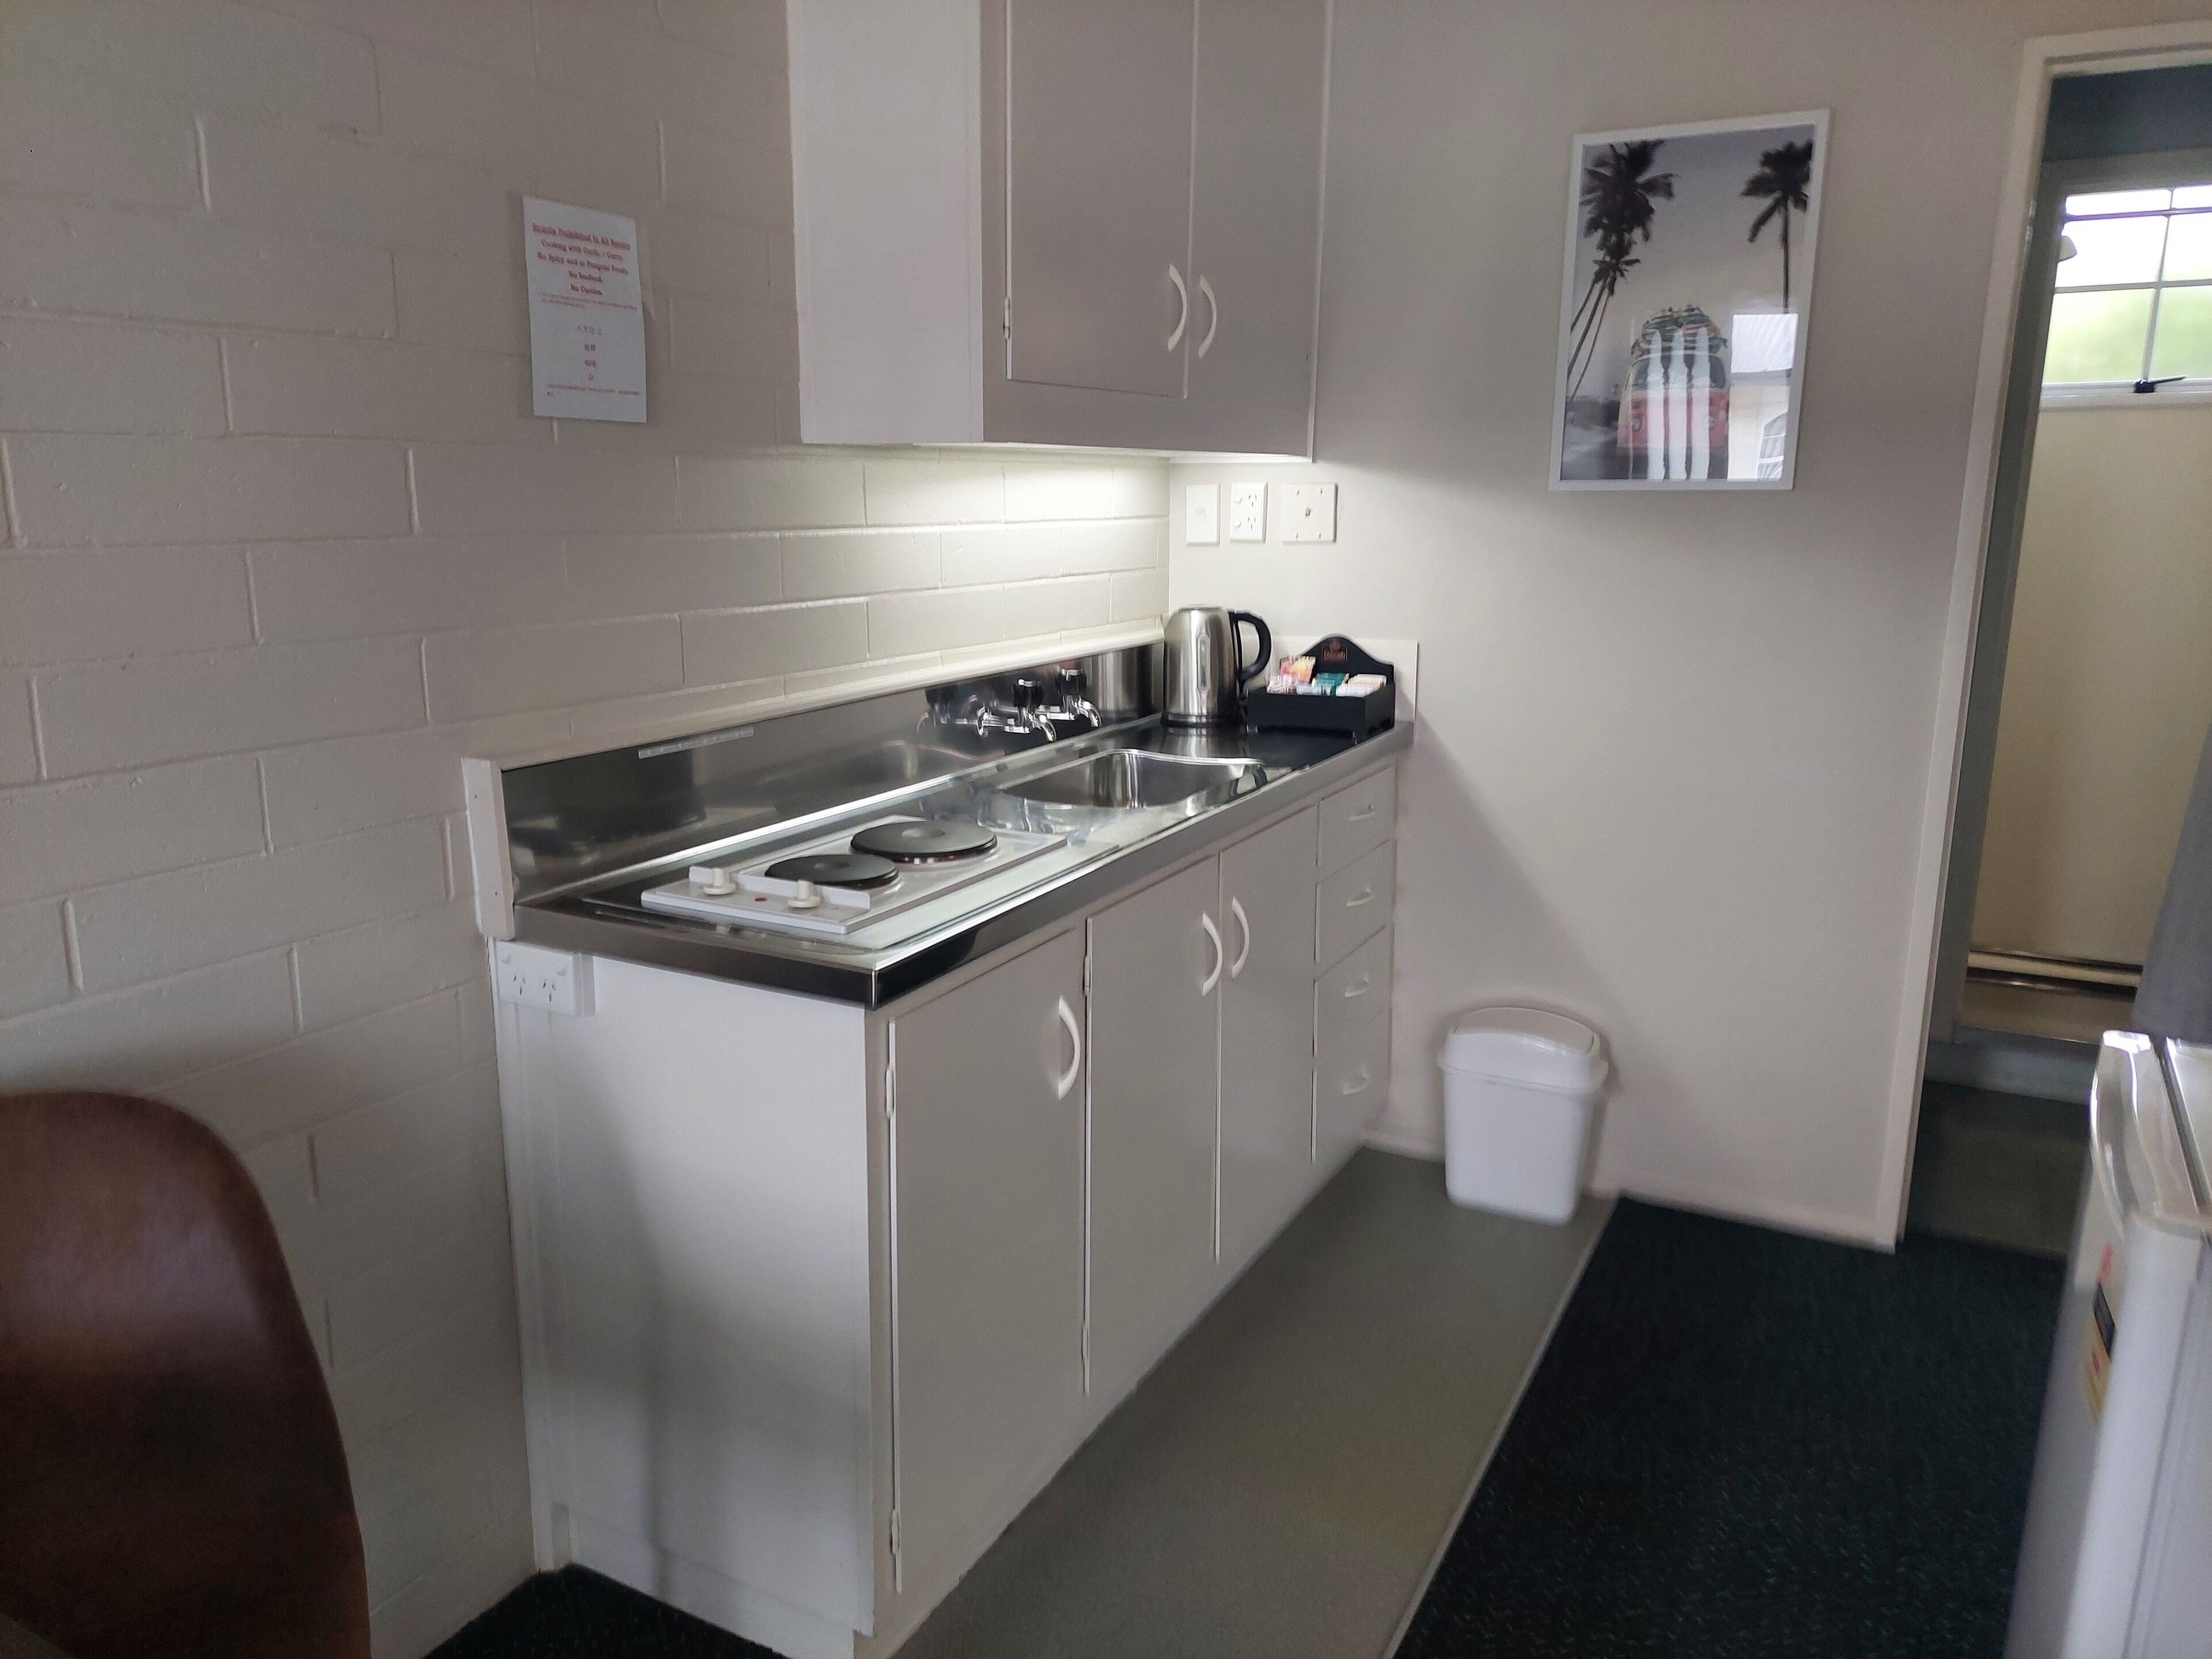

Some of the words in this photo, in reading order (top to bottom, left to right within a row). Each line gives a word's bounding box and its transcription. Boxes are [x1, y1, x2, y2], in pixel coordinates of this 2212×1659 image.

[558, 228, 591, 242] Prohibited
[601, 236, 609, 245] All
[541, 239, 566, 252] Cooking
[569, 245, 581, 253] with
[537, 252, 546, 260] No
[548, 254, 564, 264] Spicy
[587, 260, 610, 271] Pungent
